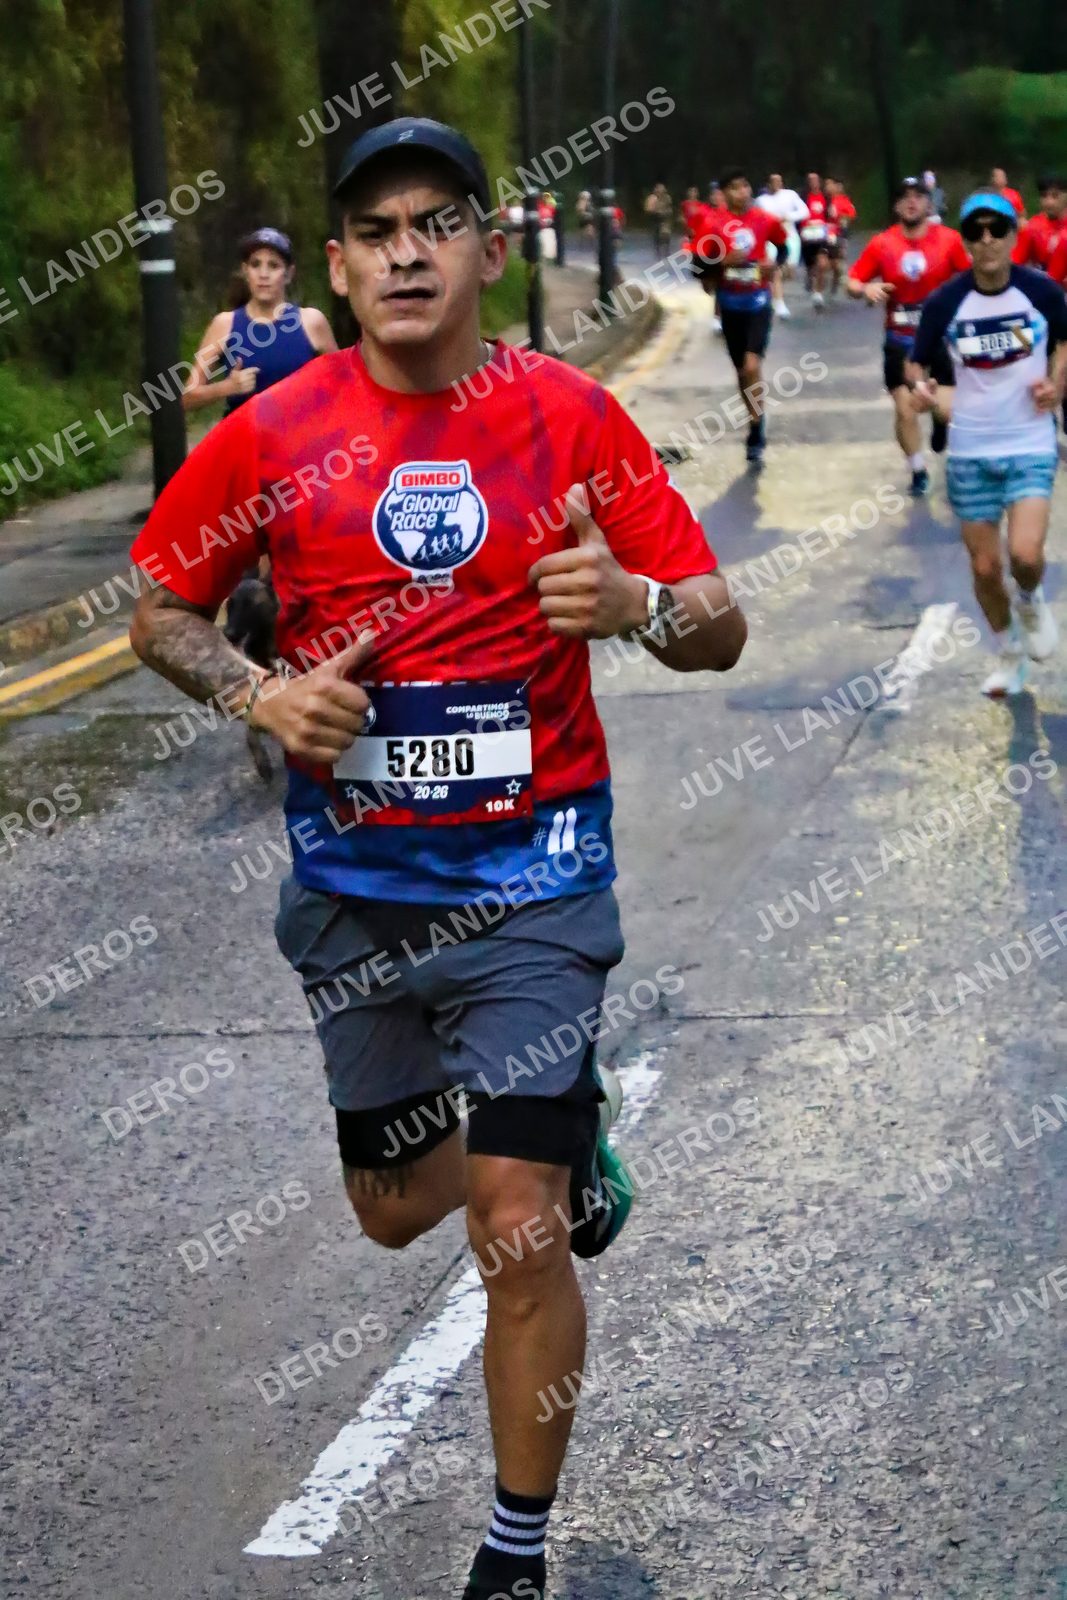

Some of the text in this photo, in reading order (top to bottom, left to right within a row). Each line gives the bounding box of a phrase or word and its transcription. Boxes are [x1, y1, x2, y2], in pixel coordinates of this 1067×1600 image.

[401, 472, 461, 487] BIMBO
[402, 492, 460, 512] Global
[390, 511, 438, 530] Race
[387, 738, 474, 777] 5280
[485, 800, 515, 813] 10K
